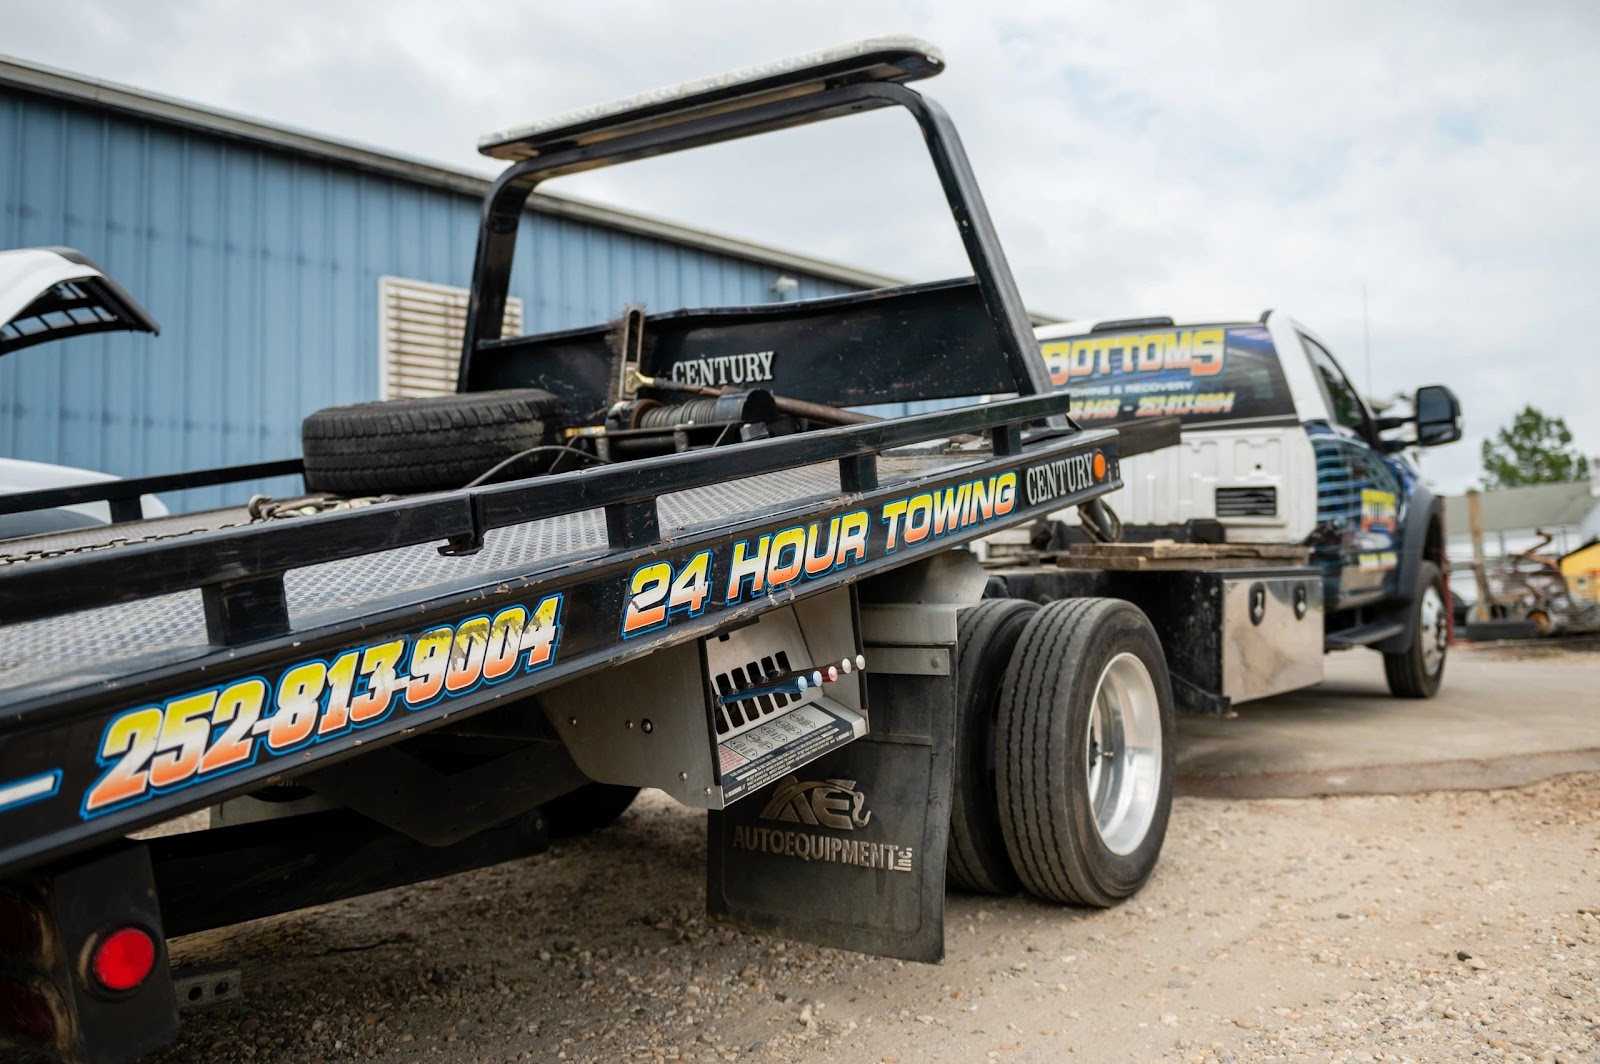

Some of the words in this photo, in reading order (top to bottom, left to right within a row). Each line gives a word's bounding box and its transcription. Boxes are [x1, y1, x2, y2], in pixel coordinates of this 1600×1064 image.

[671, 350, 775, 387] CENTURY
[1042, 328, 1226, 386] BOTTOMS
[1125, 381, 1193, 394] RECOVERY
[1026, 452, 1094, 506] CENTURY
[622, 551, 710, 635] 24
[727, 510, 869, 601] HOUR
[884, 472, 1017, 551] TOWING
[84, 594, 561, 813] 252-813-9004
[731, 825, 899, 871] AUTOEQUIPMENT
